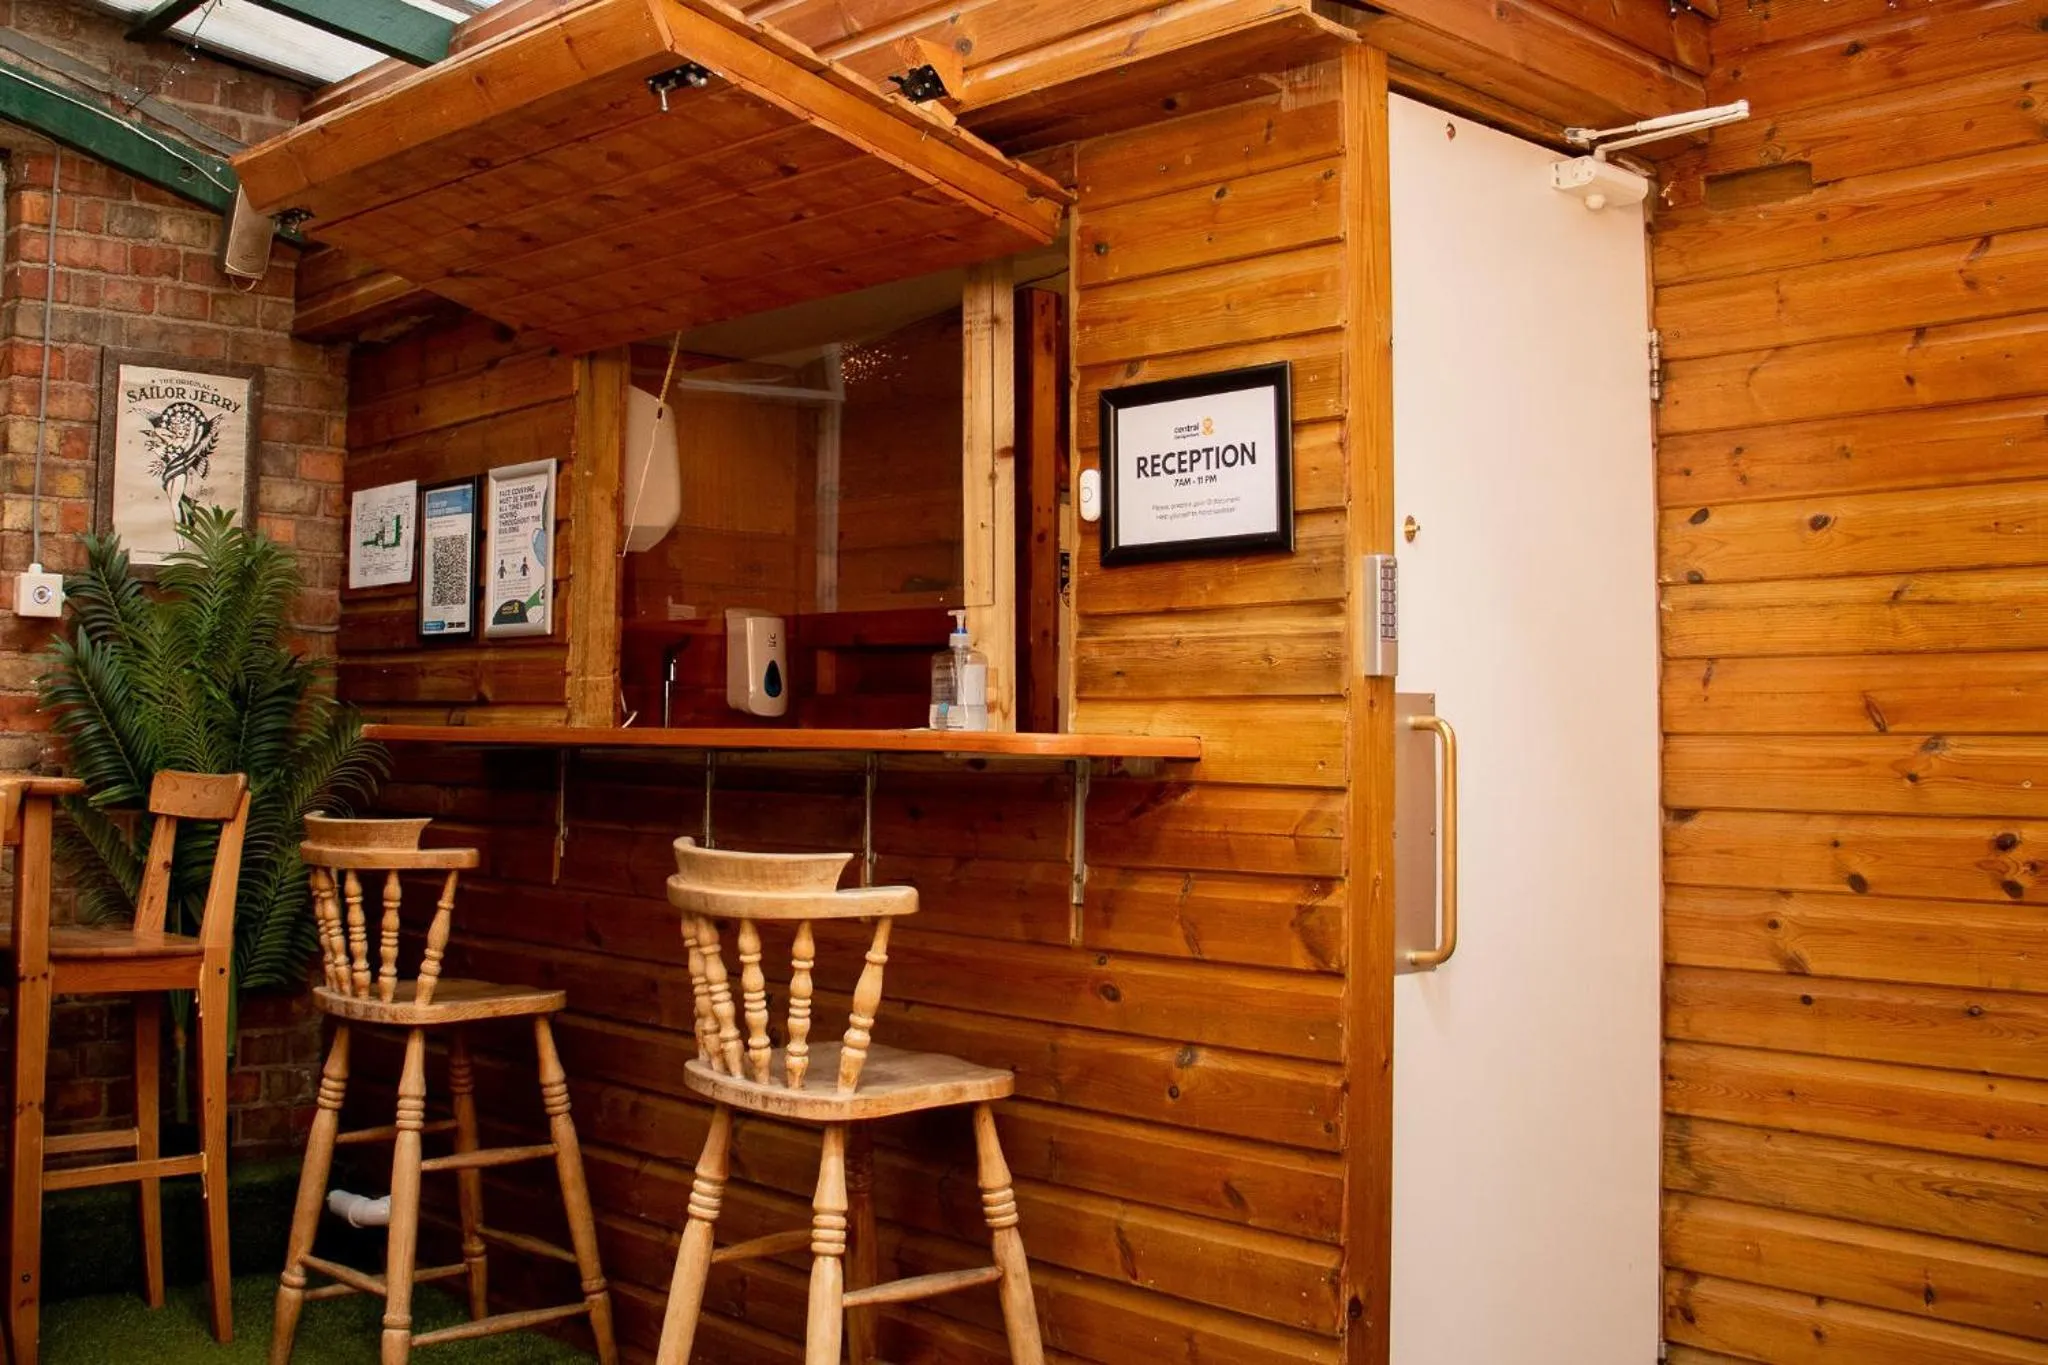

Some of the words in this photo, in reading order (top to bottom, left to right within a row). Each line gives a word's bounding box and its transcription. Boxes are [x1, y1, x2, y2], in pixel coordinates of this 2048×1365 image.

[126, 386, 186, 403] SAILOR
[189, 389, 241, 413] JERRY
[1173, 422, 1199, 433] central
[1136, 441, 1256, 479] RECEPTION
[1205, 474, 1217, 484] PM
